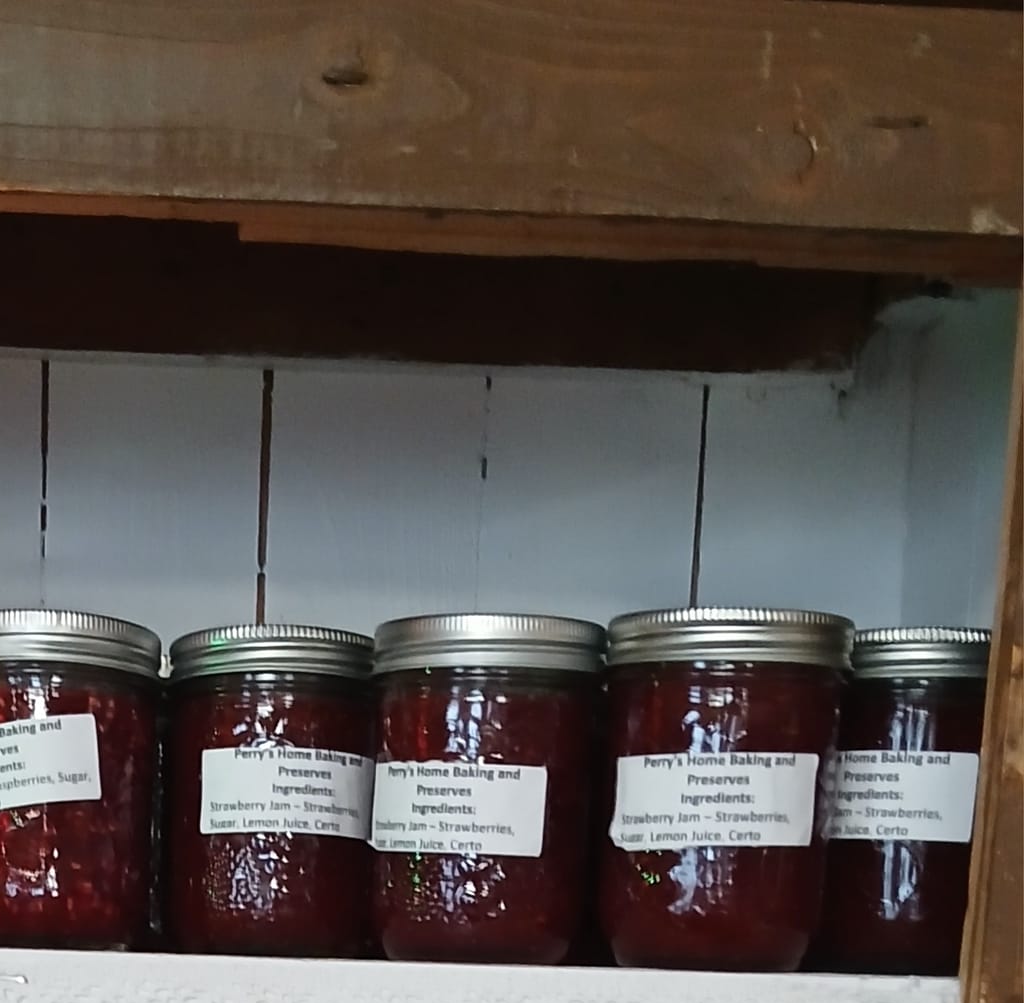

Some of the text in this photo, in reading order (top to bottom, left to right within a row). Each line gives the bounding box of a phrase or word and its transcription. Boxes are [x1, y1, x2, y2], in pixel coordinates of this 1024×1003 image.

[39, 719, 62, 731] and
[234, 749, 363, 767] Perry's Home Baking and
[644, 754, 796, 769] Perry's Home Baking and
[844, 753, 877, 765] Home
[881, 752, 923, 766] Baking
[927, 754, 951, 765] and
[58, 771, 92, 784] Sugar,
[278, 766, 332, 780] Preserves
[388, 766, 521, 781] Perry's Home Baking and
[687, 774, 750, 786] Preserves
[844, 771, 900, 783] Preserves
[272, 783, 336, 797] Ingredients:
[416, 785, 472, 797] Preserves
[837, 788, 904, 802] Ingredients:
[681, 792, 755, 806] Ingredients:
[210, 800, 266, 813] Strawberry
[269, 801, 291, 811] Jam
[411, 803, 477, 816] Ingredients:
[621, 812, 674, 826] Strawberry
[678, 812, 700, 823] Jam
[864, 807, 943, 821] Strawberries,
[242, 817, 280, 828] Lemon
[314, 819, 341, 833] Certo
[408, 821, 427, 832] Jam
[438, 821, 516, 837] Strawberries,
[876, 825, 909, 836] Certo
[650, 830, 688, 842] Lemon
[728, 830, 761, 842] Certo
[450, 838, 482, 851] Certo
